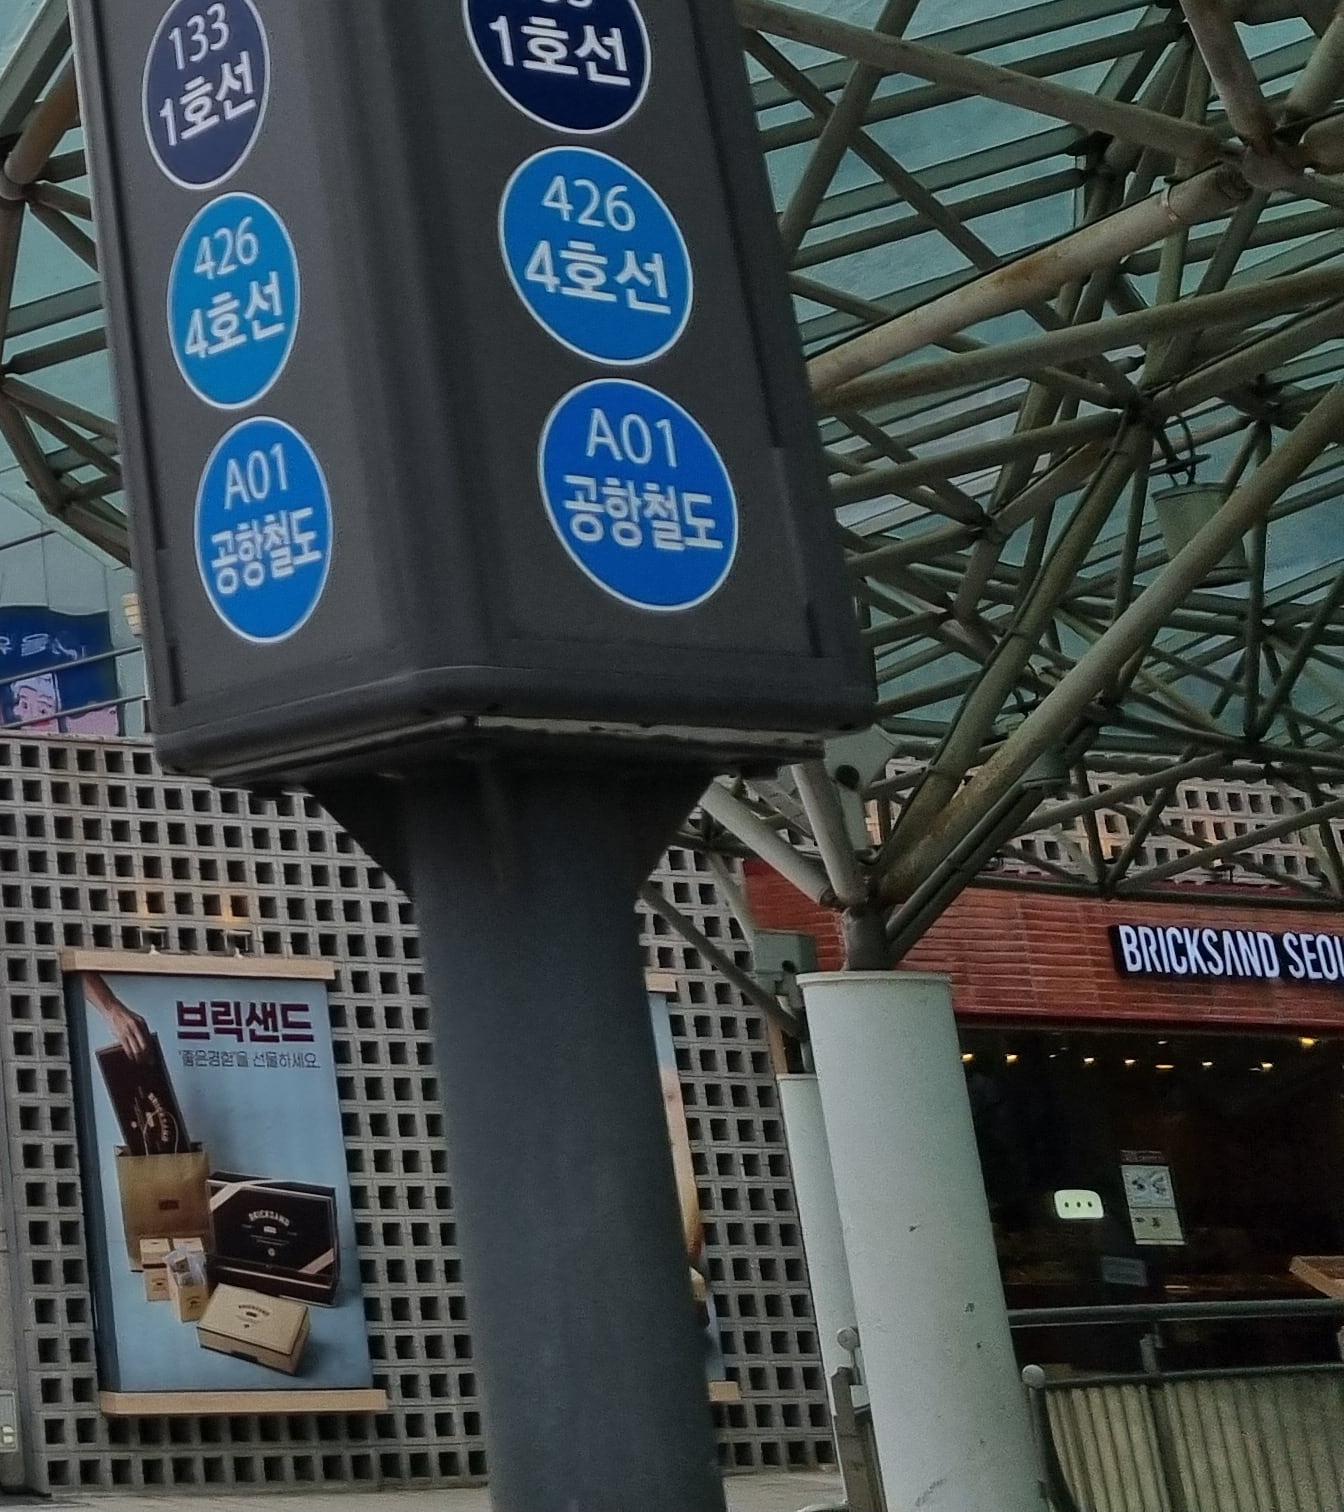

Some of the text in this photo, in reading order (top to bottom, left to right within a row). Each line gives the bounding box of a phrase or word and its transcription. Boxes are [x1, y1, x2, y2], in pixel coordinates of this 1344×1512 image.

[168, 2, 230, 71] 133
[489, 16, 632, 88] 1호선
[159, 50, 257, 148] 1호선
[542, 175, 636, 234] 426
[193, 216, 260, 281] 426
[524, 238, 672, 316] 4호선
[184, 271, 285, 361] 4호선
[586, 408, 680, 469] A01
[223, 442, 290, 512] A01
[562, 473, 724, 554] 공항철도
[211, 506, 322, 596] 공항철도
[1118, 924, 1280, 978] BRICKSAND
[176, 1001, 315, 1043] 브릭샌드
